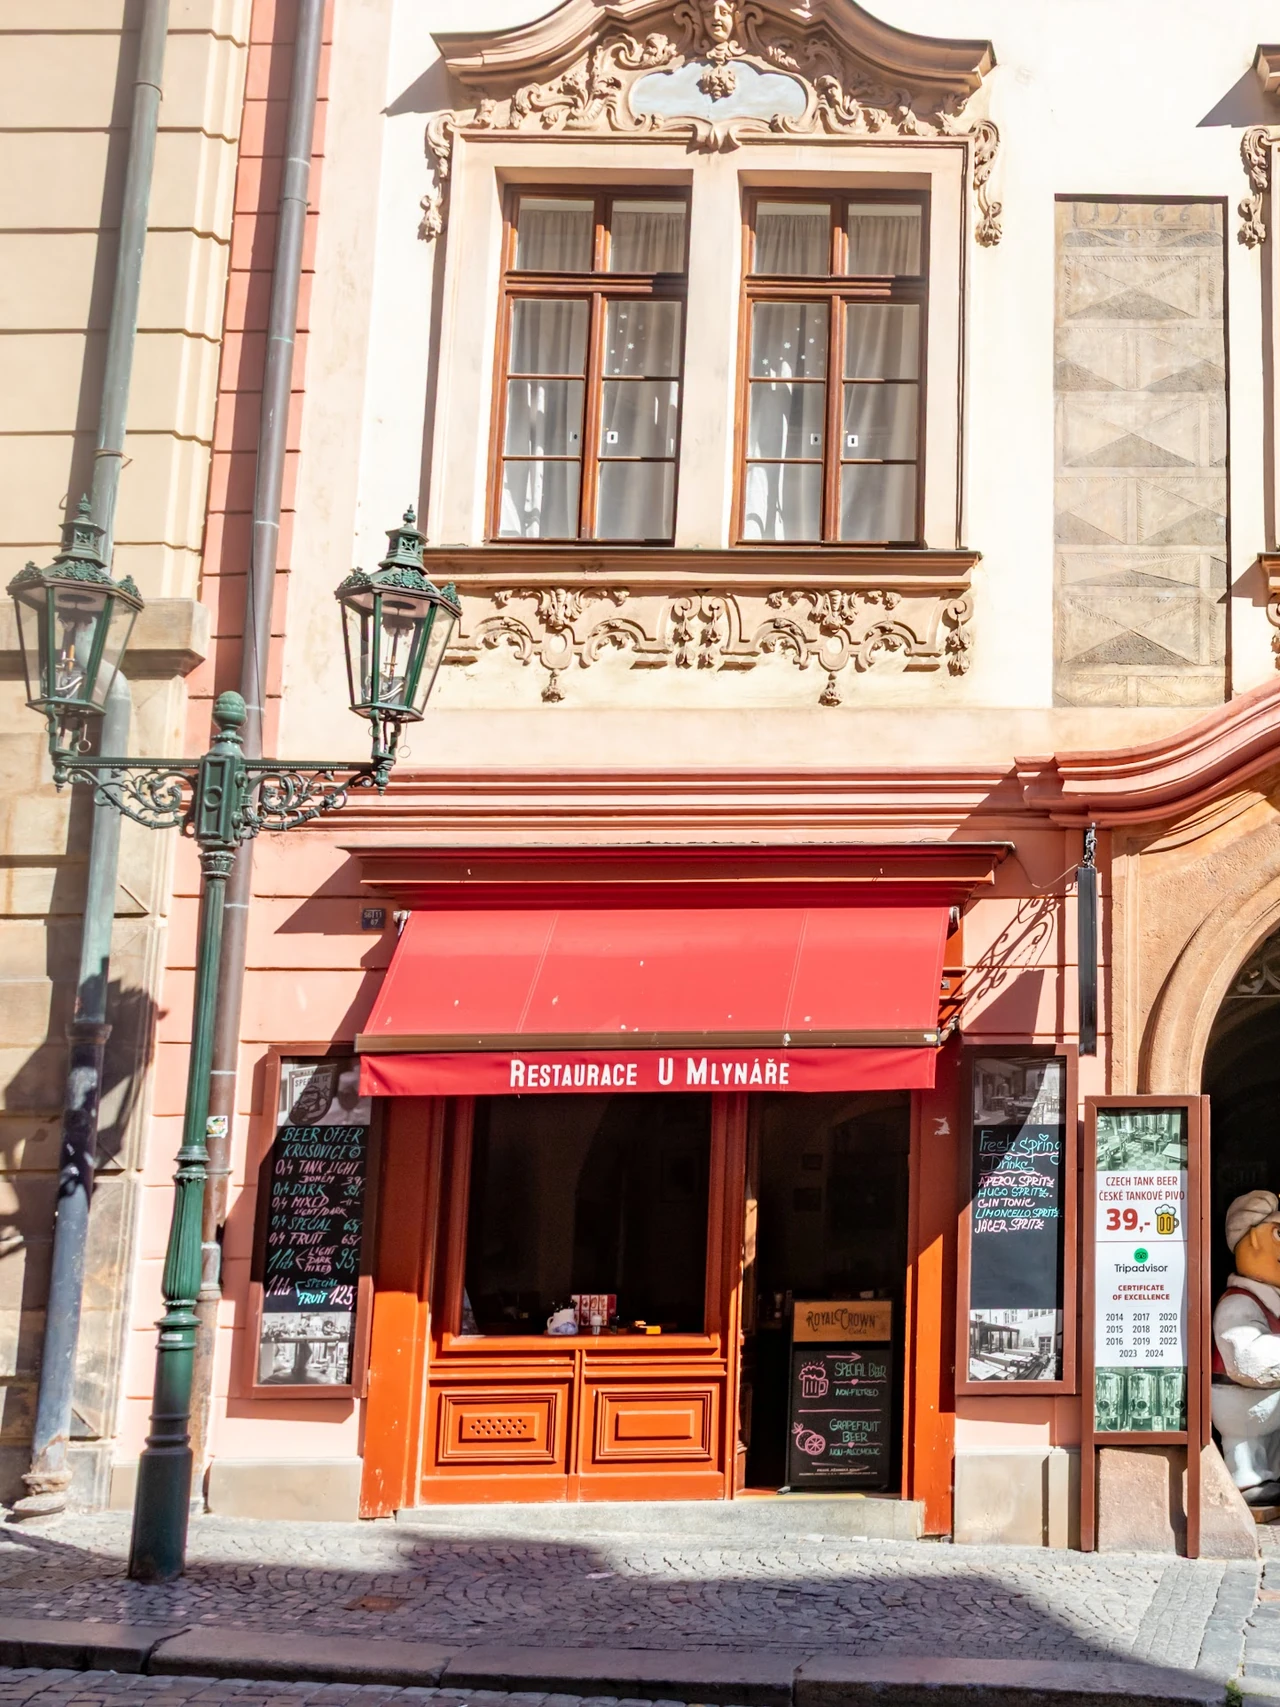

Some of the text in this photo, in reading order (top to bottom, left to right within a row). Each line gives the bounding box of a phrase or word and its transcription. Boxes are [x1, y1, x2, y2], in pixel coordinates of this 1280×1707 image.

[509, 1059, 638, 1087] RESTAURACE
[658, 1057, 673, 1085] U
[282, 1127, 364, 1144] BEER OFFER
[275, 1159, 364, 1175] 0,4 TANK LIGHT
[978, 1175, 1055, 1188] APEROL SPRITZ
[1106, 1176, 1178, 1186] CZECH TANK BEER
[273, 1182, 290, 1196] 0,4
[290, 1184, 326, 1197] DARK
[978, 1188, 1008, 1198] HUGO
[1099, 1189, 1185, 1201] ČESKÉ TANKOVÉ PIVO
[271, 1197, 288, 1212] 0,4
[291, 1195, 329, 1208] MIXED
[978, 1197, 1035, 1208] GIN TONIC
[271, 1215, 287, 1229] 0,4
[287, 1217, 332, 1231] SPECIAL
[1009, 1218, 1044, 1231] SPRITZ
[269, 1232, 286, 1246] 0,4
[289, 1232, 327, 1245] FRUIT
[308, 1245, 338, 1256] LIGHT
[307, 1256, 332, 1265] DARK
[304, 1265, 332, 1275] MIXED
[1114, 1263, 1168, 1274] Tripadvisor
[298, 1290, 328, 1306] FRUIT
[1106, 1313, 1178, 1321] 2014 2017 2020
[1106, 1325, 1177, 1333] 2015 2018 2021
[1106, 1338, 1123, 1346] 2016
[1119, 1350, 1137, 1358] 2023
[834, 1362, 887, 1378] SPECIAL BEER
[829, 1418, 881, 1432] GRAPEFRUIT
[842, 1431, 869, 1443] BEER
